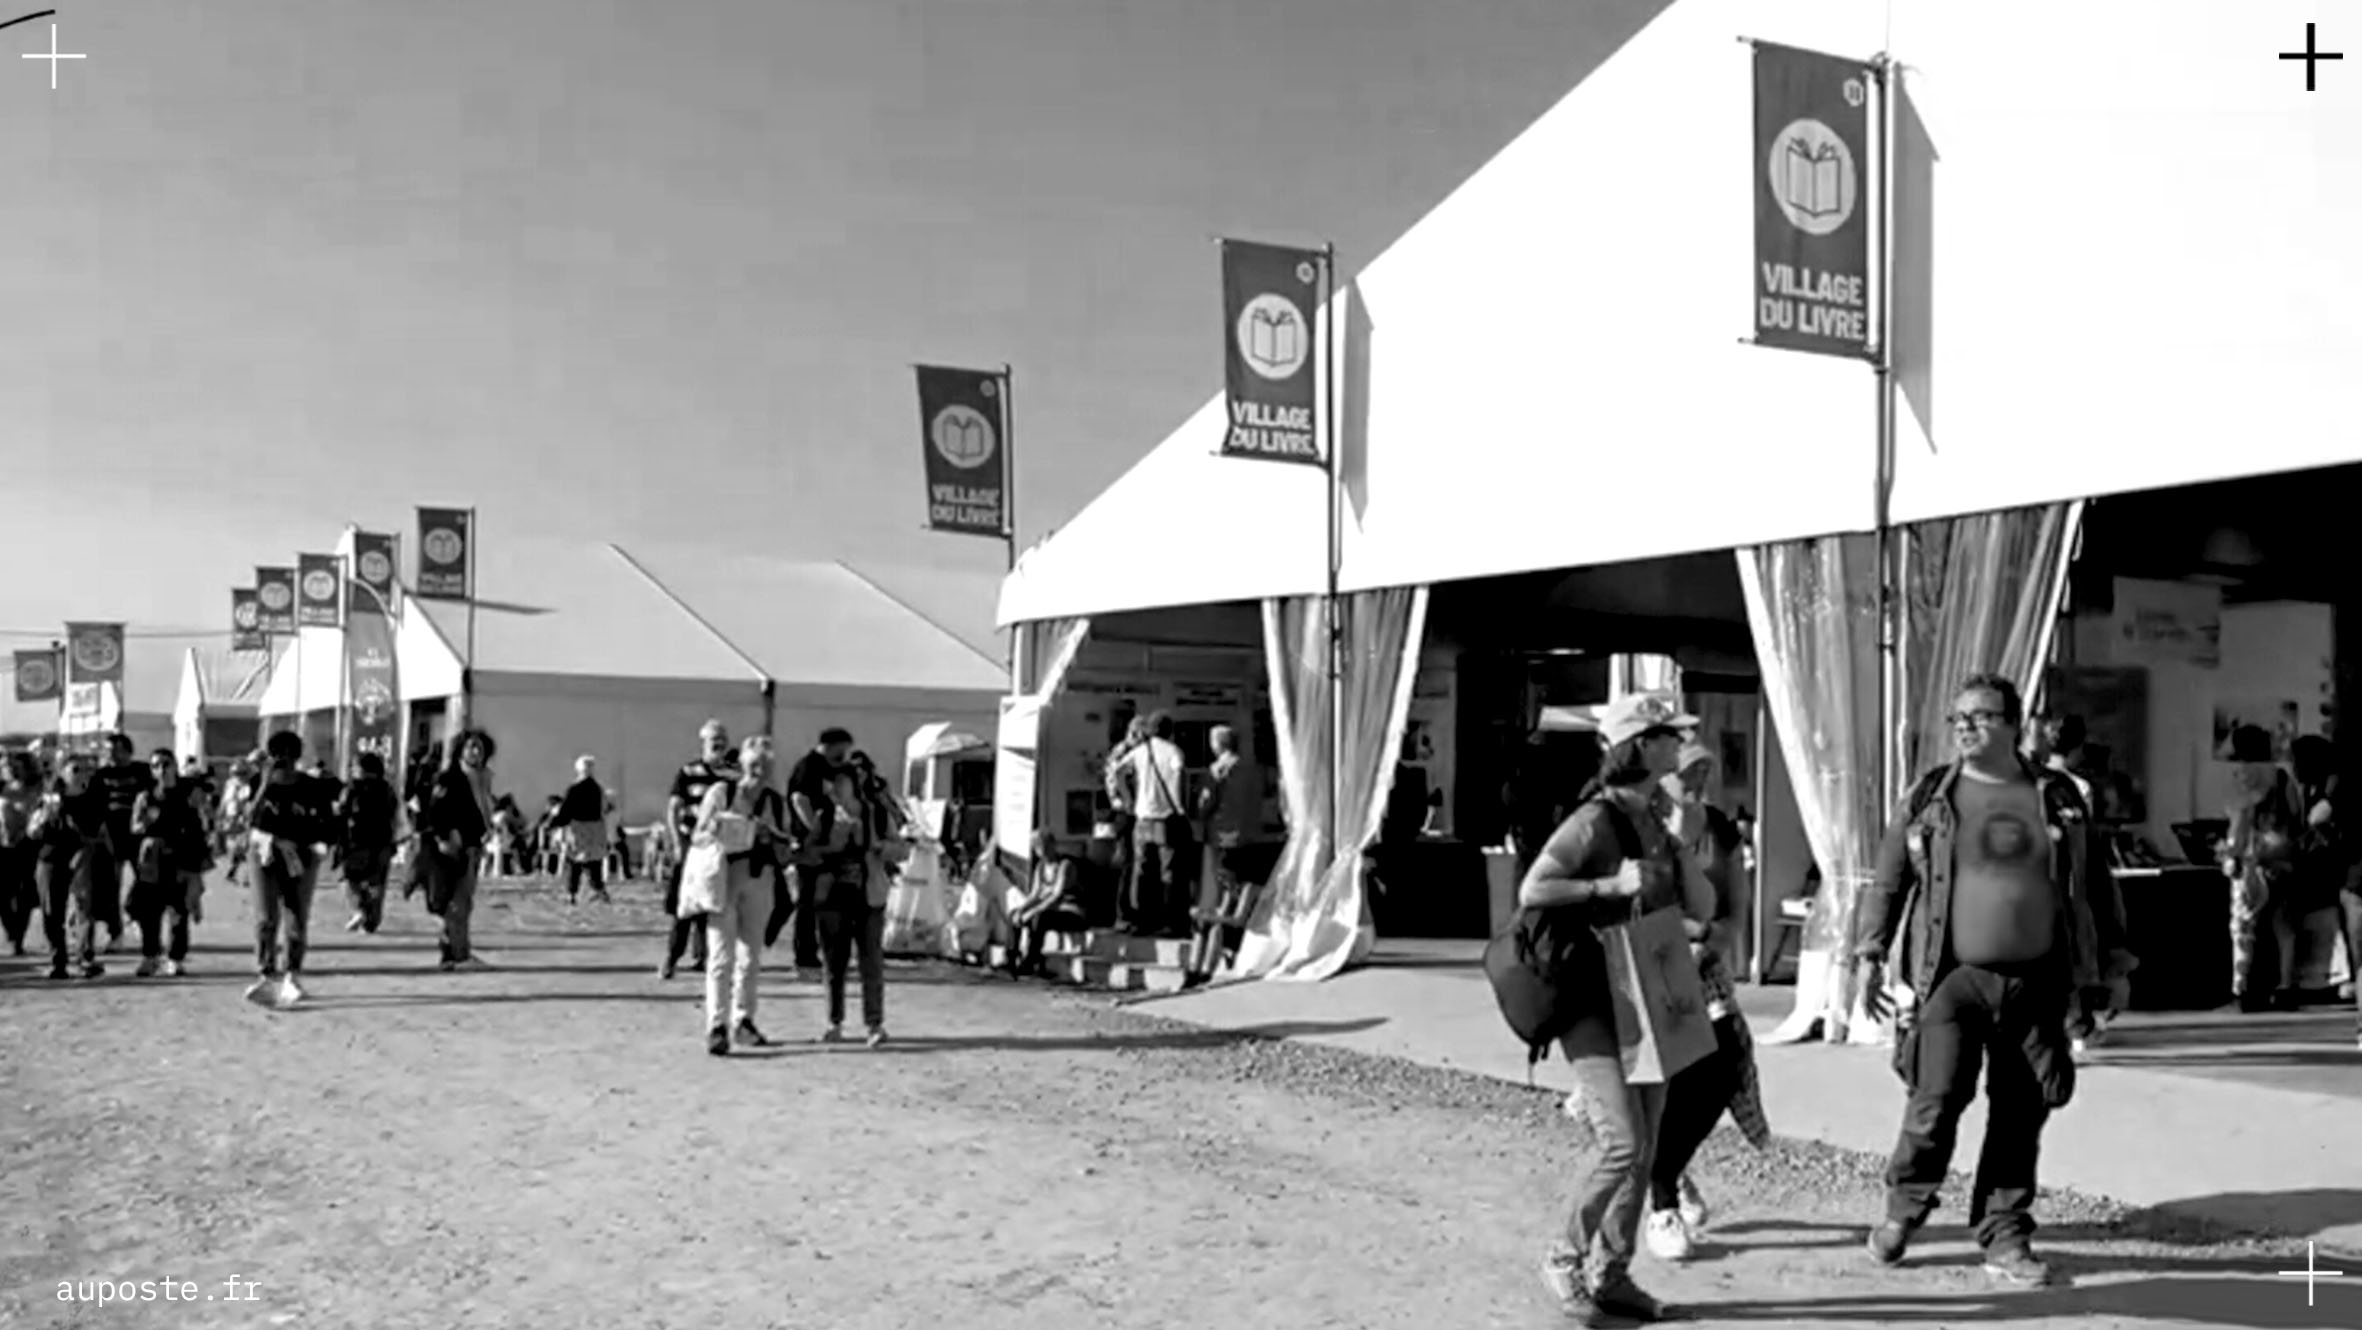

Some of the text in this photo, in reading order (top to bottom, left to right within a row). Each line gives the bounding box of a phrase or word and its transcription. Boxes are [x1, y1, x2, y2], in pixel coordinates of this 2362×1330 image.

[1762, 261, 1863, 306] VILLAGE
[1759, 296, 1865, 341] DU LIVRE
[1231, 401, 1312, 430] VILLAGE
[1229, 424, 1315, 455] DU LIVRE
